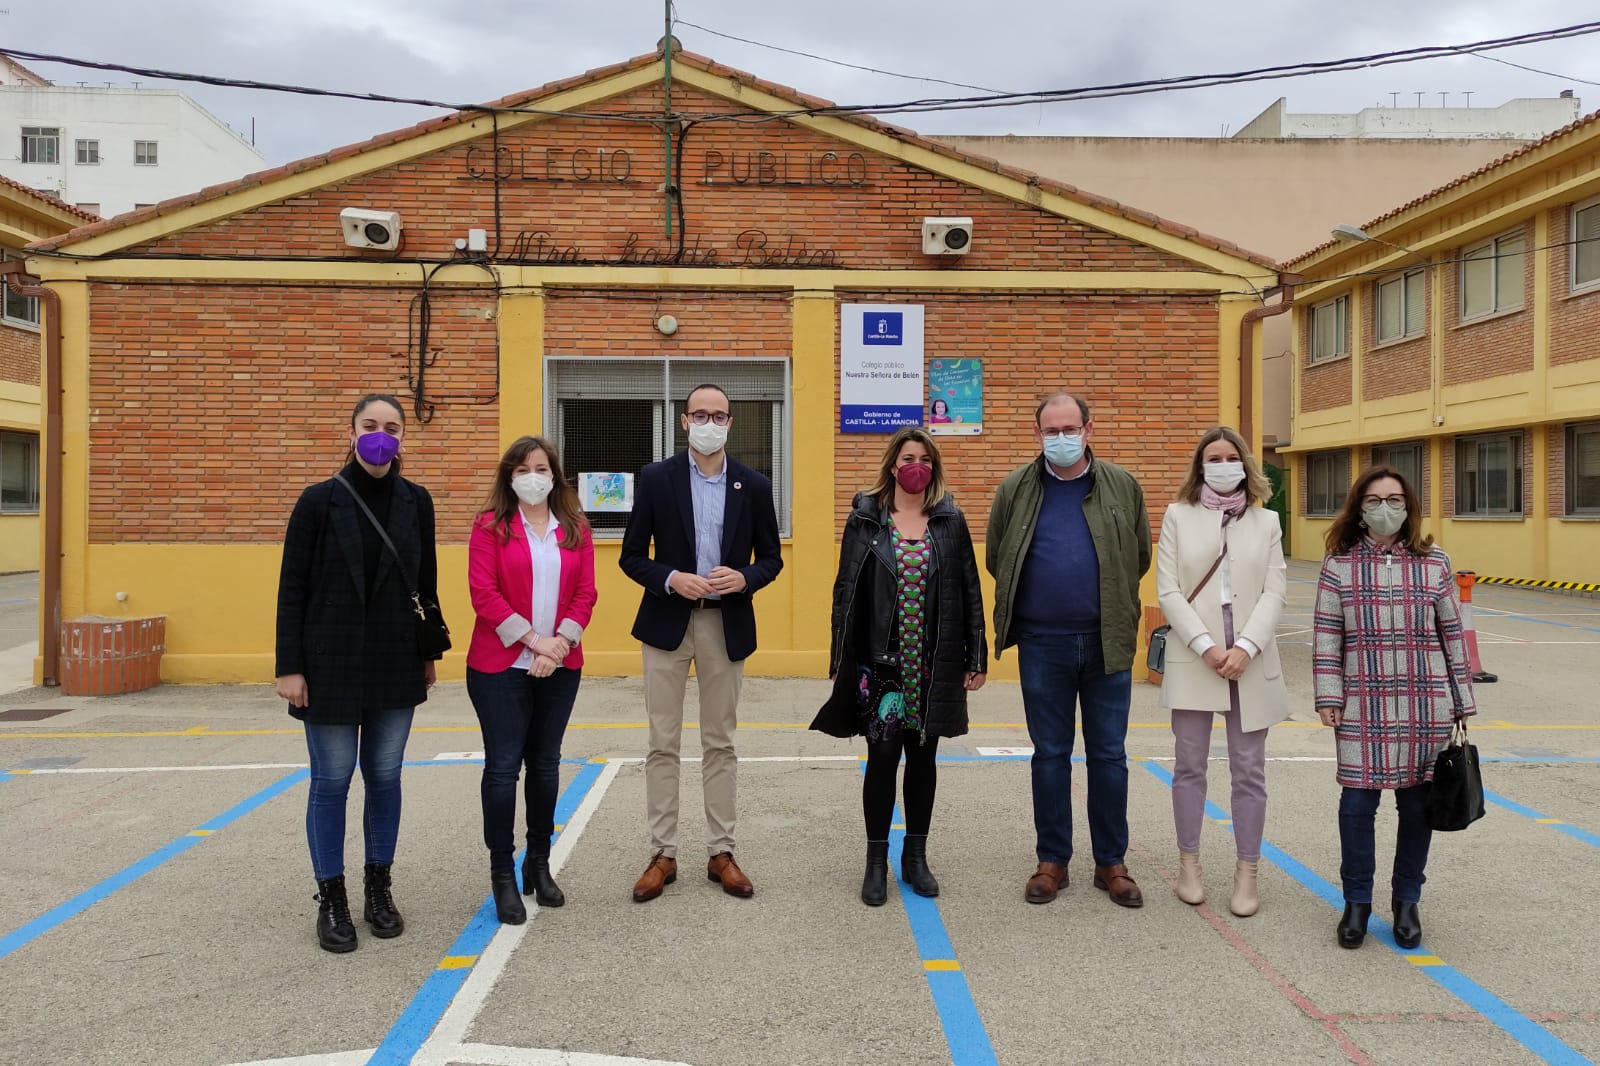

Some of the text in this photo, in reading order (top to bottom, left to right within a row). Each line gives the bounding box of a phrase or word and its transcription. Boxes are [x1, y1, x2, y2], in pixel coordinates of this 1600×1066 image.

[466, 147, 867, 185] COLEGIO PUBLICO
[861, 361, 905, 370] Colegio público
[870, 371, 892, 379] Señora
[893, 371, 901, 379] de
[902, 371, 920, 379] Belén
